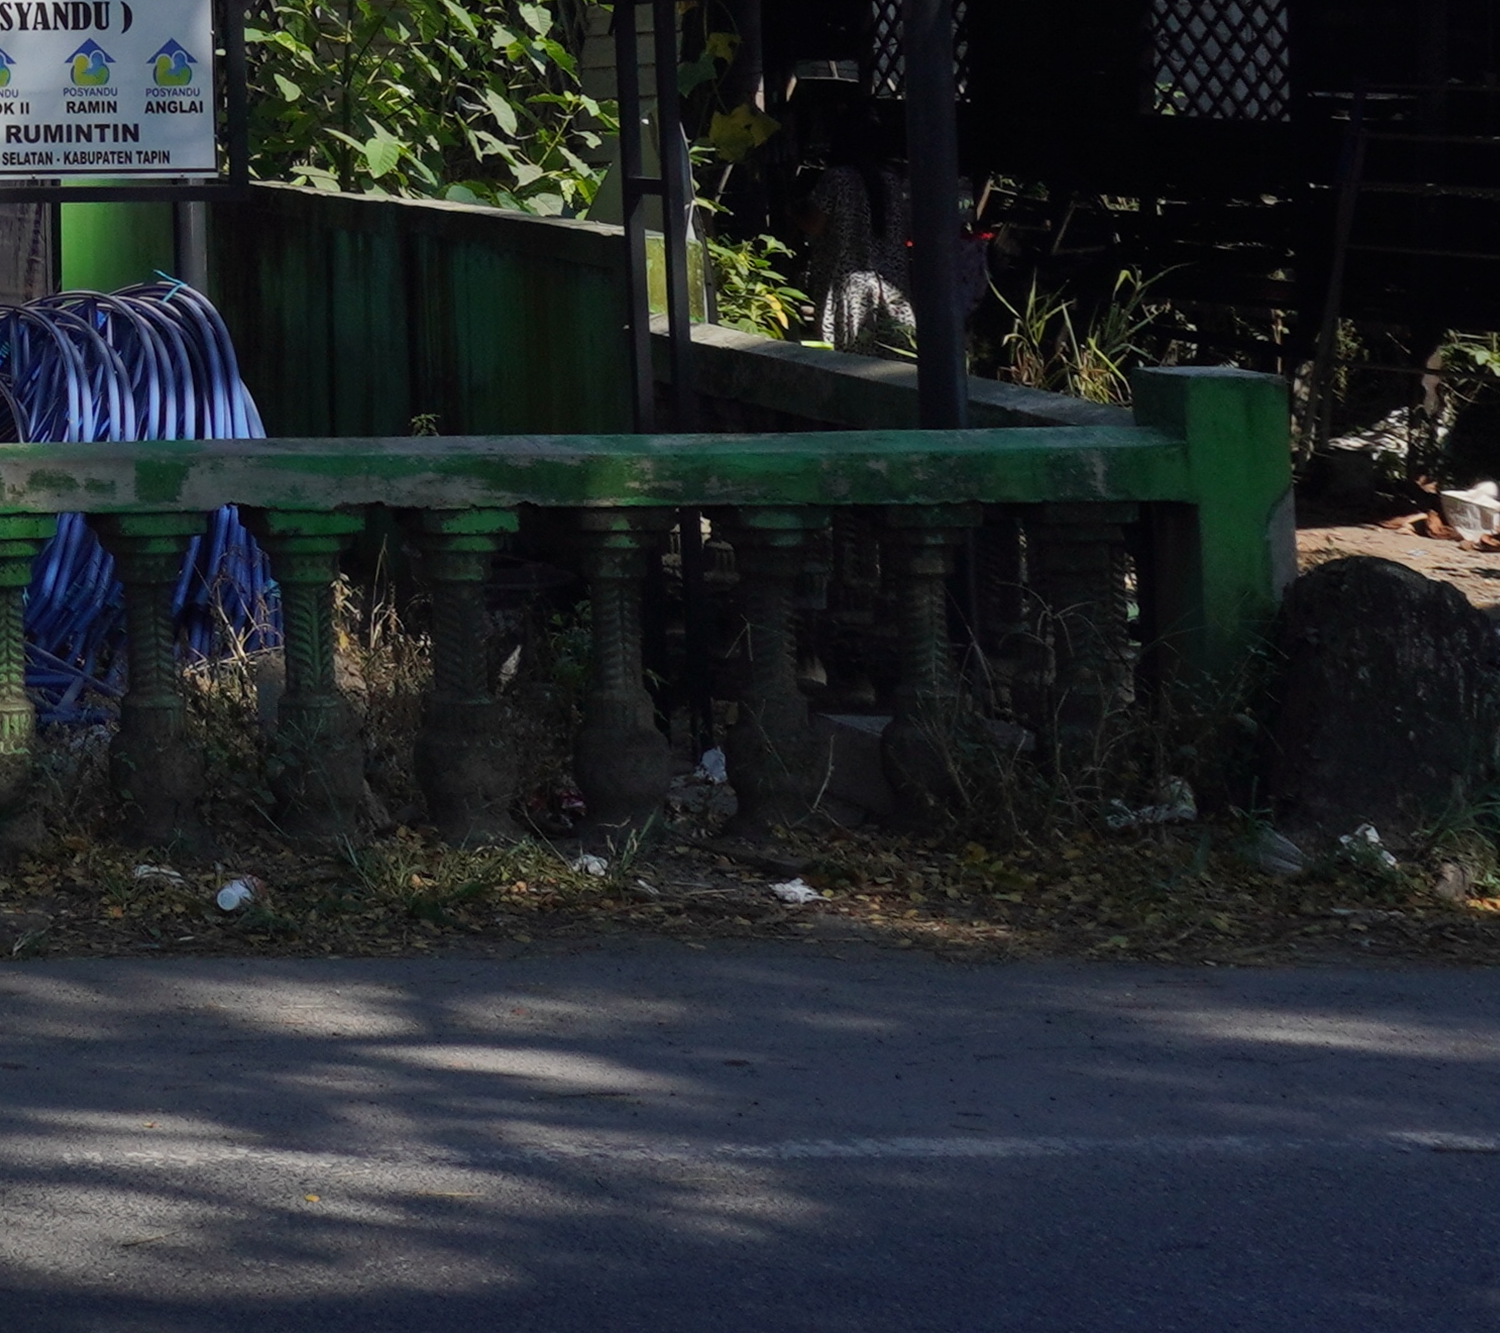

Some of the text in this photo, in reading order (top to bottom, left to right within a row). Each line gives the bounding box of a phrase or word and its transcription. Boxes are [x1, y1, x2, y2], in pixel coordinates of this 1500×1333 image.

[63, 87, 118, 97] POSYANDU
[146, 87, 200, 97] POSYANDU
[21, 101, 30, 114] II
[66, 101, 117, 114] RAMIN
[145, 100, 203, 114] ANGLAI
[6, 123, 140, 143] RUMINTIN
[2, 151, 53, 165] SELATAN
[63, 151, 132, 164] KABUPATEN
[136, 150, 170, 164] TAPIN
